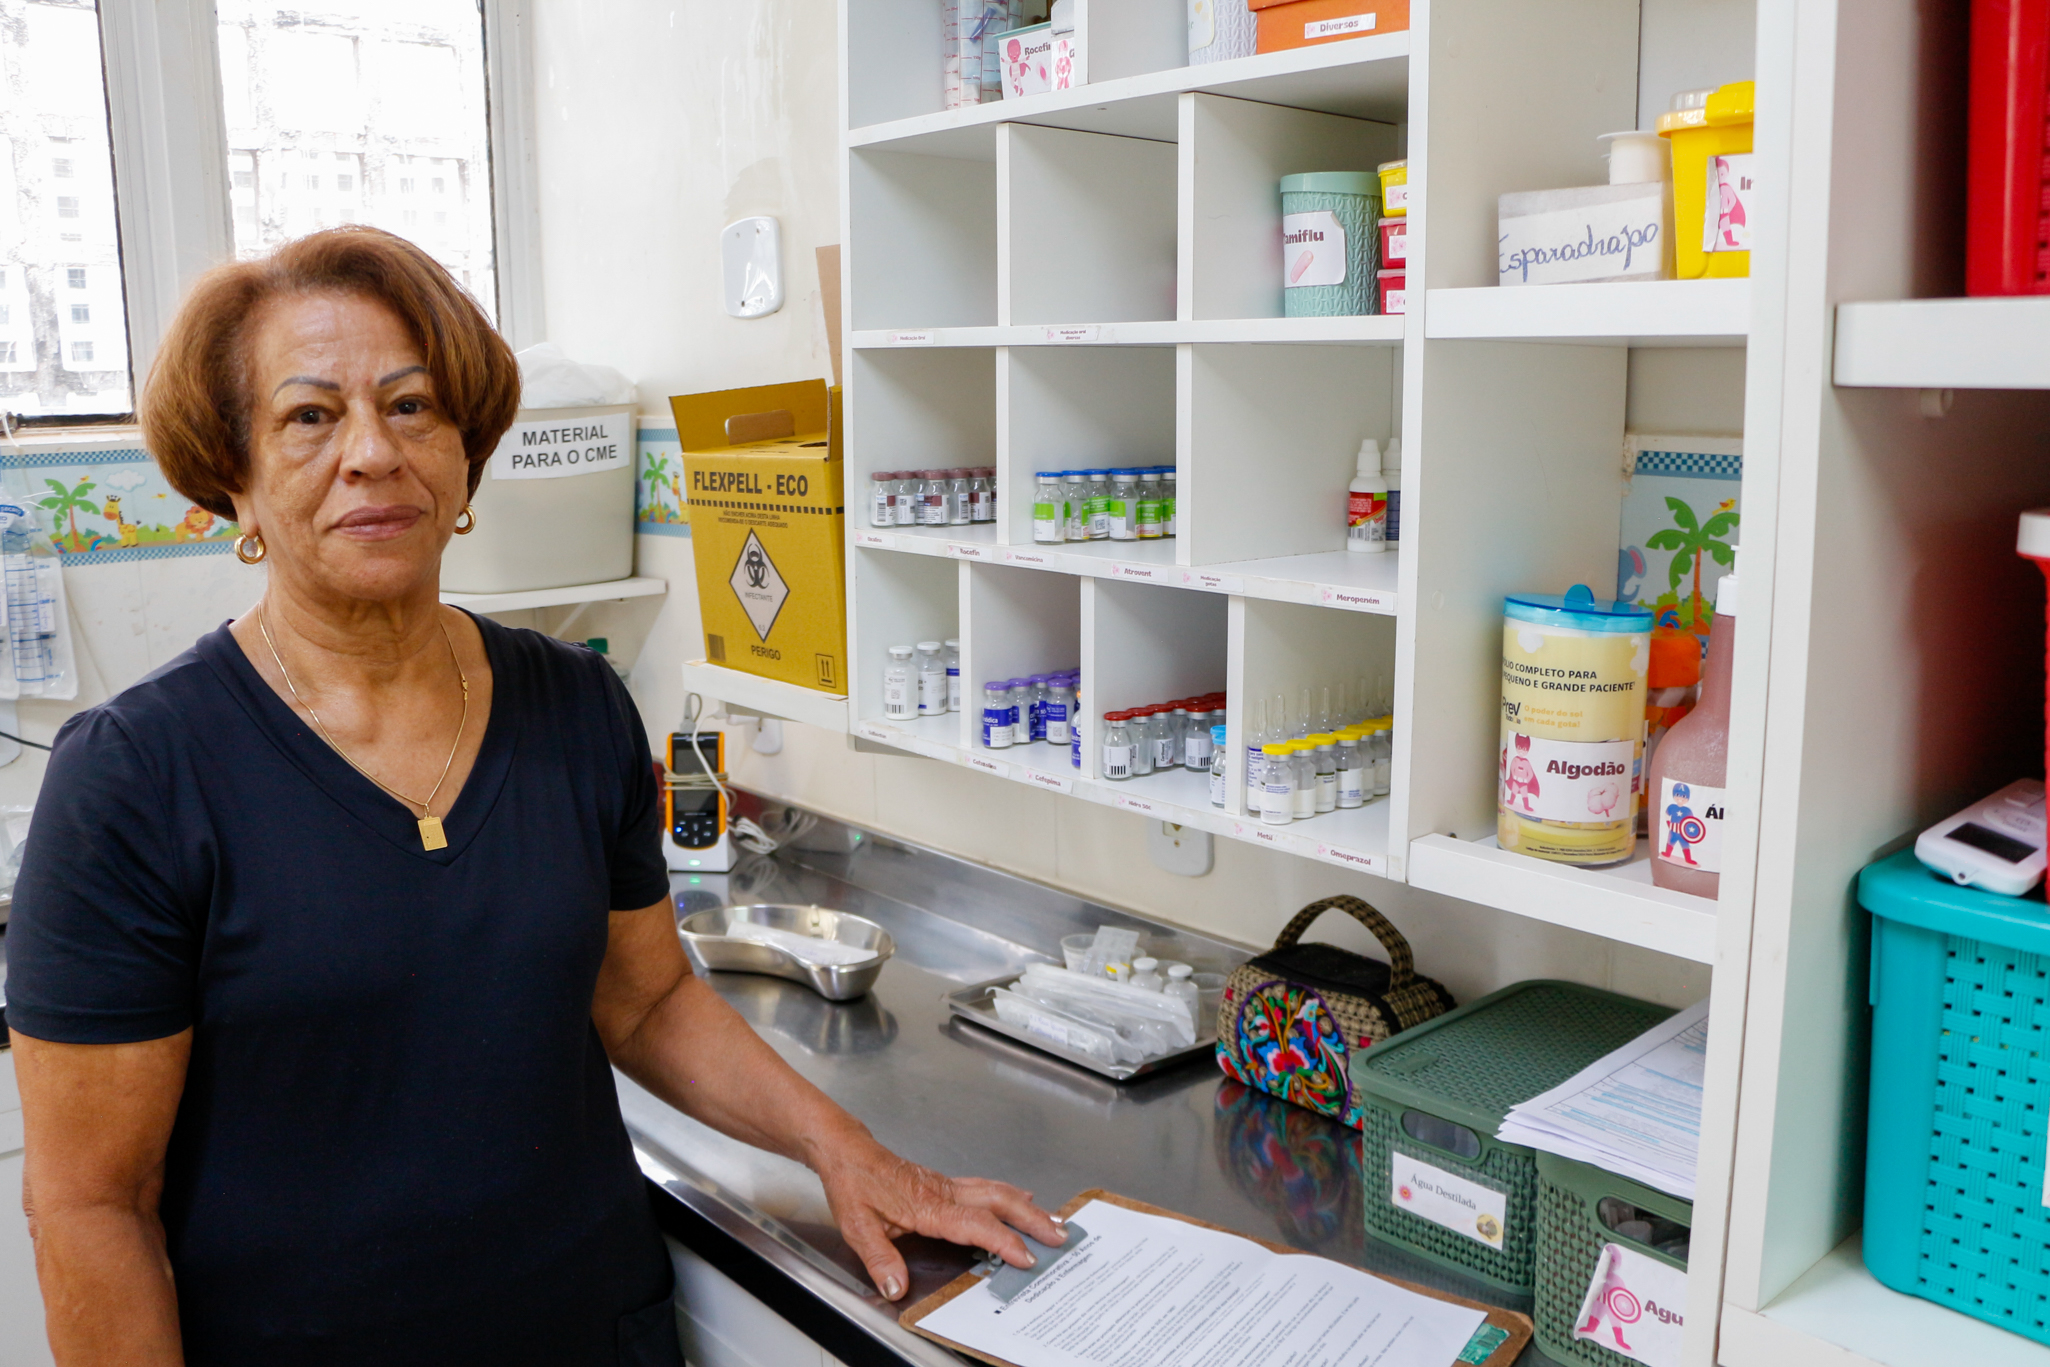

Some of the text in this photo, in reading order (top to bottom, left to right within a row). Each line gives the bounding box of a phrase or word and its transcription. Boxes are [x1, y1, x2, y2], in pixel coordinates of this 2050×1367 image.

[1319, 19, 1359, 33] Diversos
[522, 424, 609, 447] MATERIAL
[512, 444, 618, 470] PARA O CME
[693, 470, 763, 495] FLEXPELL
[776, 474, 809, 497] ECO
[1124, 567, 1152, 577] Atrovent
[751, 644, 781, 661] PERIGO
[1515, 662, 1566, 679] COMPLETO
[1568, 670, 1598, 680] PARA
[1533, 680, 1539, 688] E
[1541, 681, 1587, 693] GRANDE
[1531, 707, 1555, 716] poder
[1546, 759, 1626, 780] Algodão
[1330, 848, 1372, 866] Omeprazol
[1411, 1173, 1478, 1211] Água Destilada
